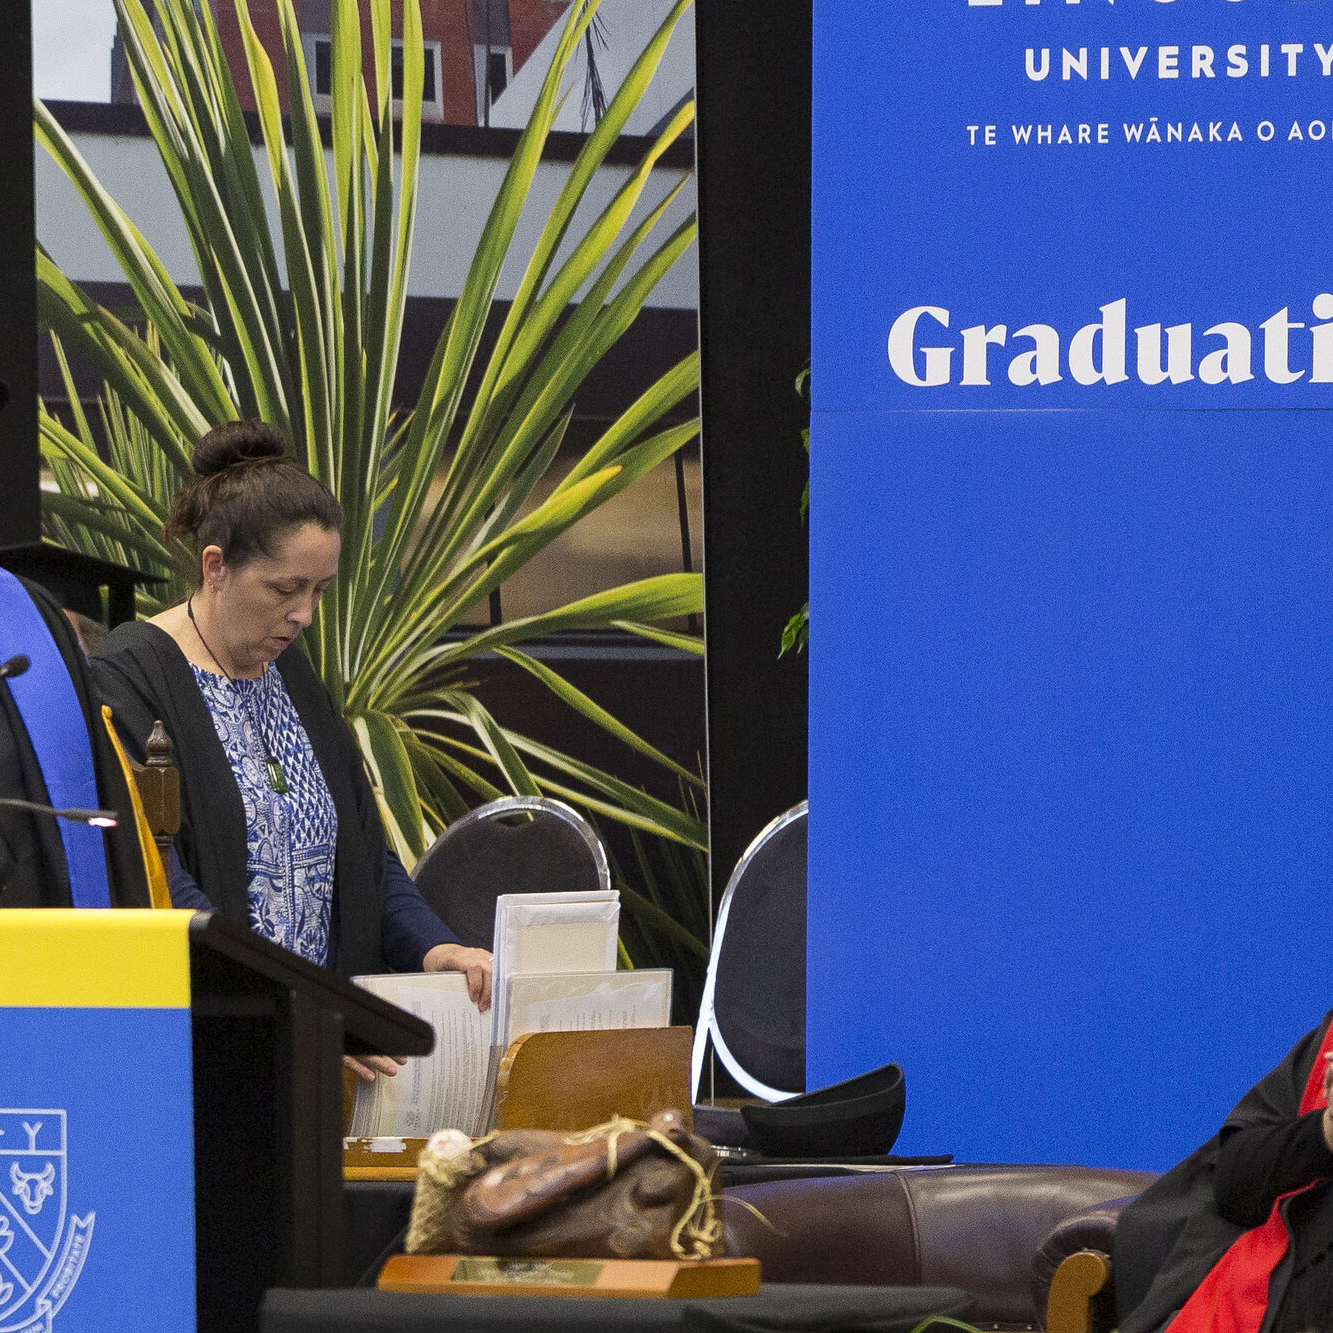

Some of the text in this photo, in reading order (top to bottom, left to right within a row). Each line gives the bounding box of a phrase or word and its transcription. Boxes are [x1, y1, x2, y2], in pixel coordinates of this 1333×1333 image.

[1024, 43, 1333, 81] UNIVERSITY
[966, 117, 1333, 145] TE WHARE WĀNAKA O AO
[887, 293, 1333, 387] Graduati
